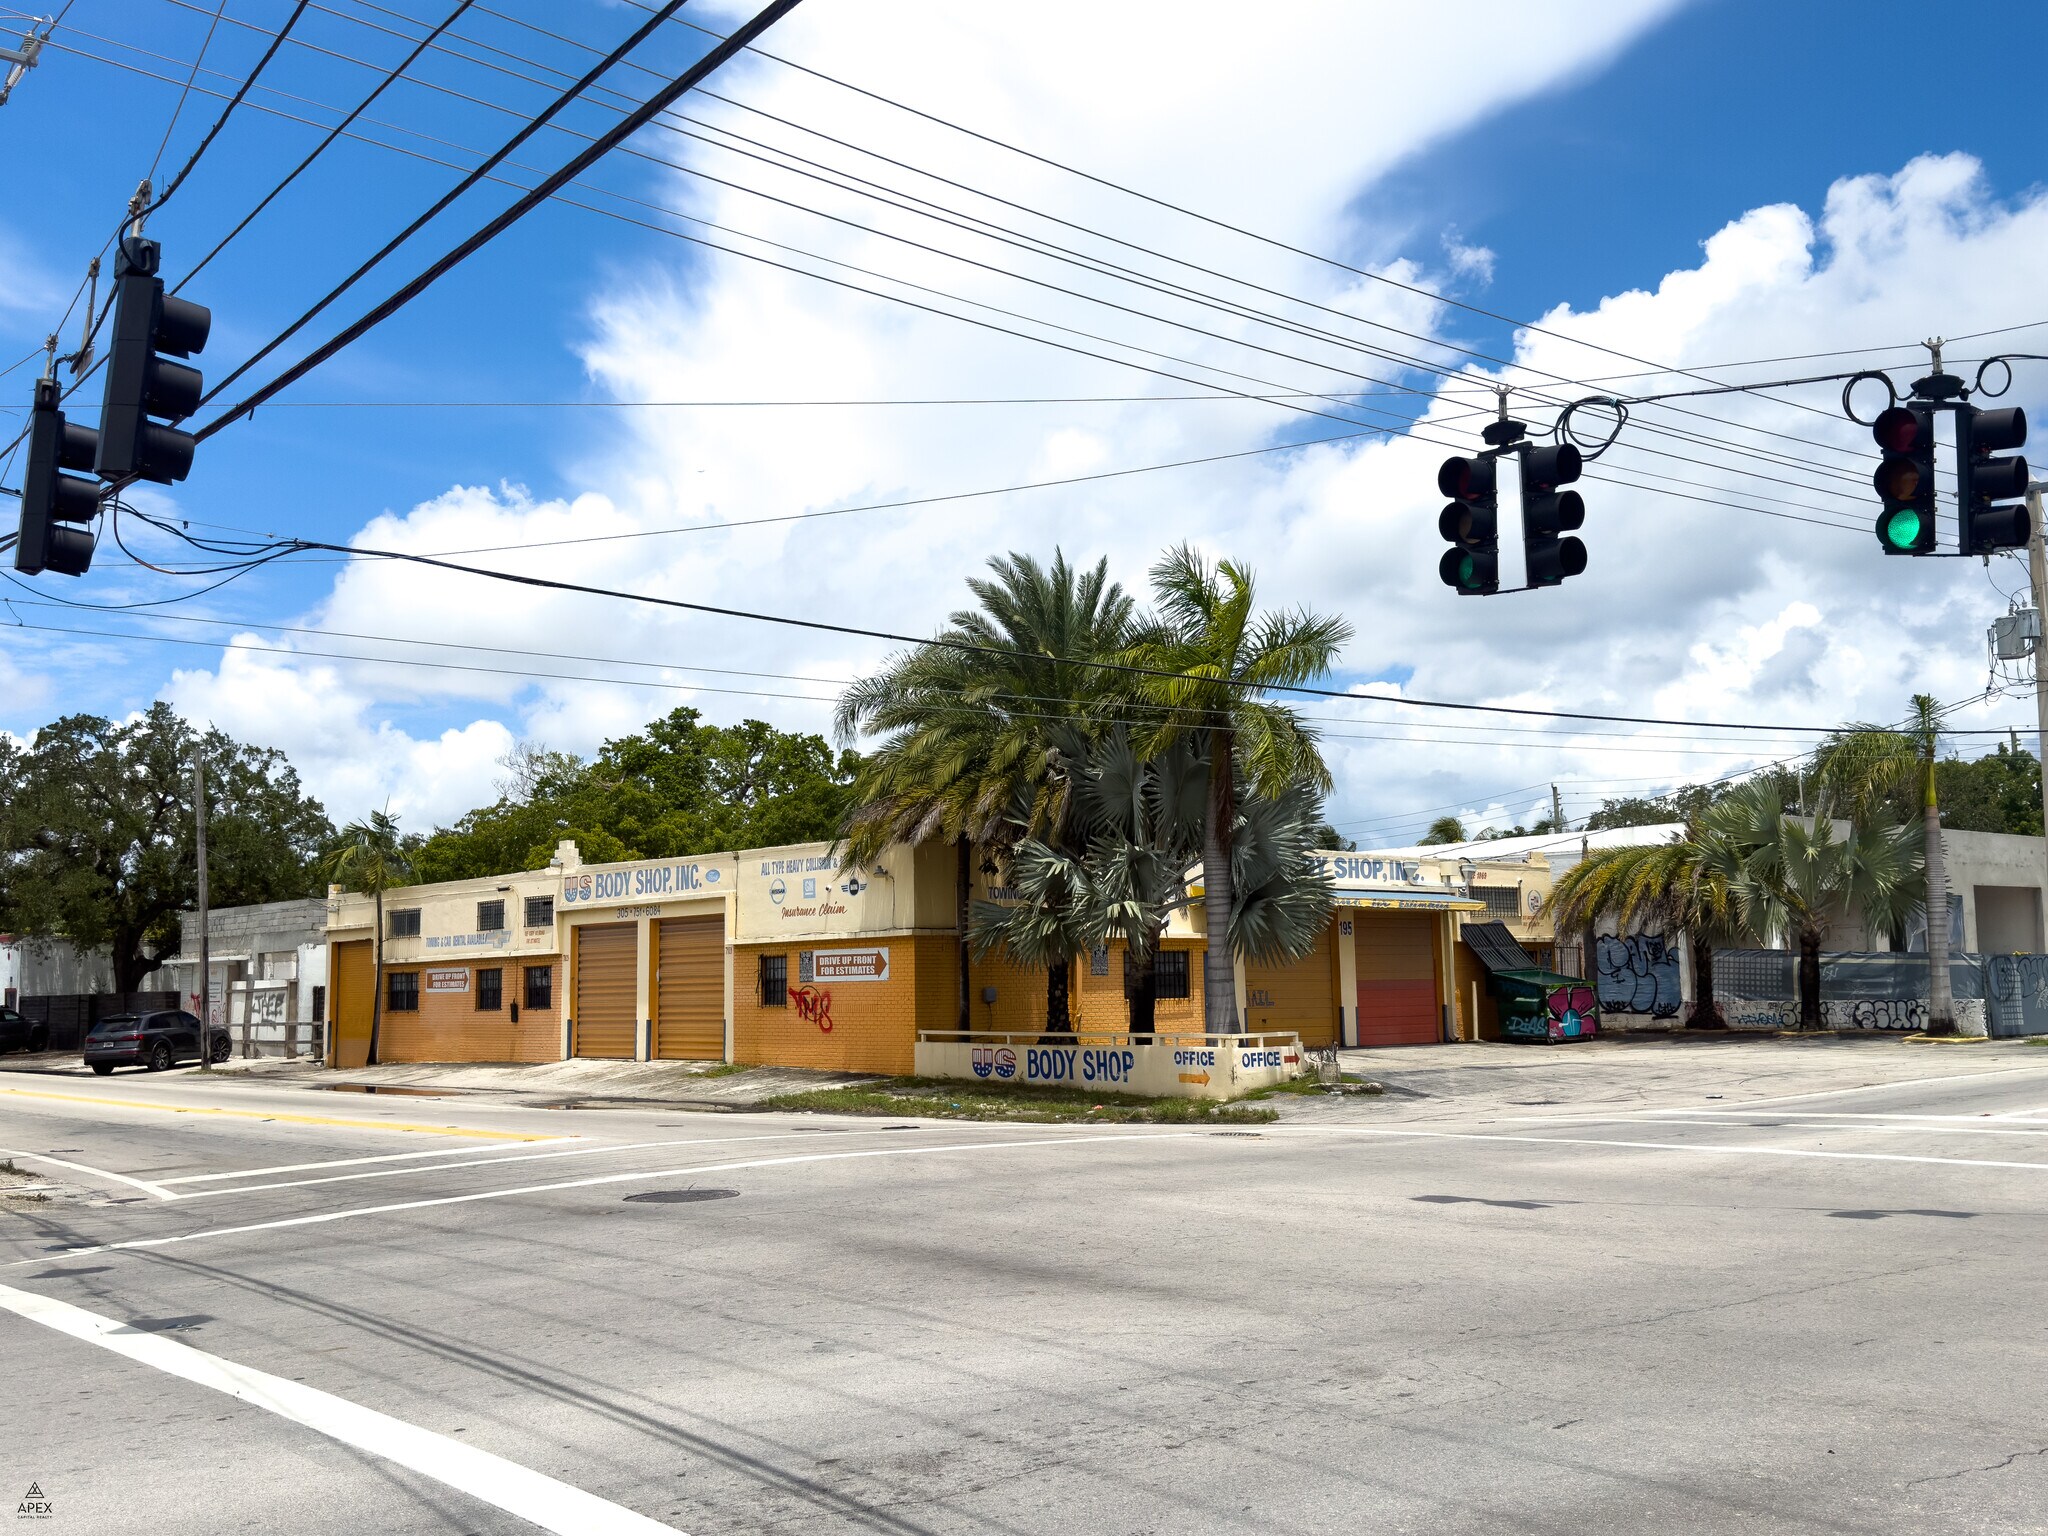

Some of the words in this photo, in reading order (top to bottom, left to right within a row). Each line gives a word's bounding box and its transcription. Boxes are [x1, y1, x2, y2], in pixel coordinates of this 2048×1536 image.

[761, 862, 770, 876] ALL
[772, 860, 785, 874] TYPE
[786, 859, 804, 873] HEAVY
[1334, 856, 1387, 882] SHOP,
[564, 875, 592, 902] US
[596, 871, 631, 898] BODY
[635, 867, 672, 895] SHOP,
[675, 864, 702, 891] INC.
[781, 905, 816, 920] Insurance
[819, 901, 848, 917] Claim
[1339, 921, 1352, 936] 195
[819, 956, 841, 965] DRIVE
[841, 956, 852, 964] UP
[853, 955, 876, 964] FRONT
[432, 973, 445, 981] DRIVE
[452, 972, 465, 980] FRONT
[820, 966, 835, 975] FOR
[835, 966, 875, 975] ESTIMATES
[441, 980, 465, 988] ESTIMATES
[971, 1048, 1017, 1078] US
[1027, 1048, 1077, 1080] BODY
[1082, 1050, 1135, 1083] SHOP
[1174, 1050, 1215, 1066] OFFICE
[1241, 1051, 1281, 1068] OFFICE
